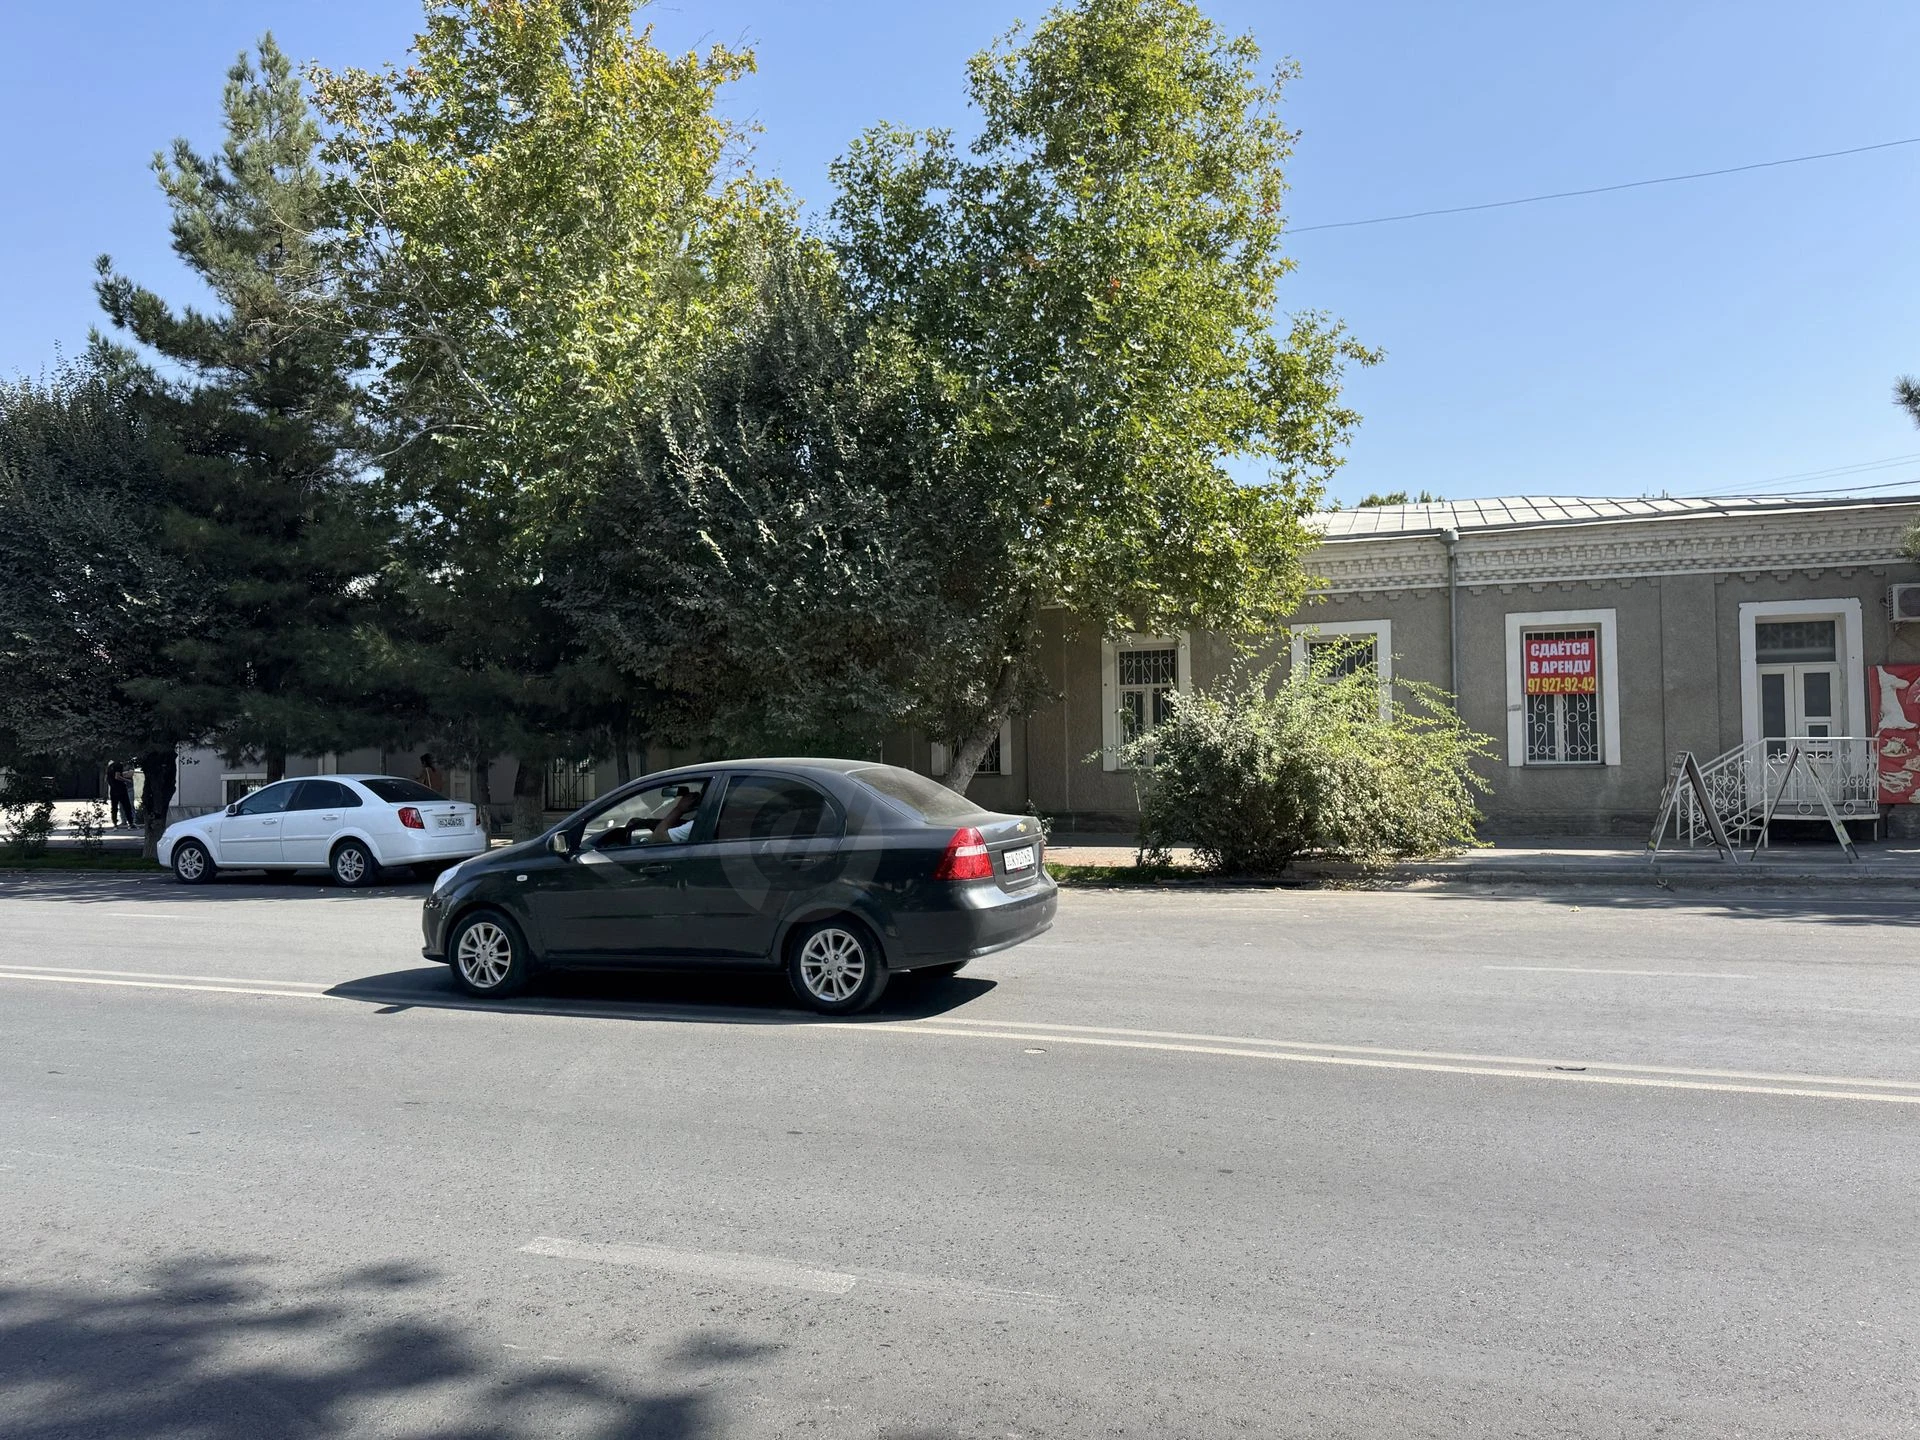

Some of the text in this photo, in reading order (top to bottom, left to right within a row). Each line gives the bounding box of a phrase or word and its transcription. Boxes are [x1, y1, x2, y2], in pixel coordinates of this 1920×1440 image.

[1530, 640, 1589, 658] СДАЁТСЯ
[1530, 660, 1591, 675] В АРЕНДУ
[1527, 676, 1595, 692] 97 927-92-42
